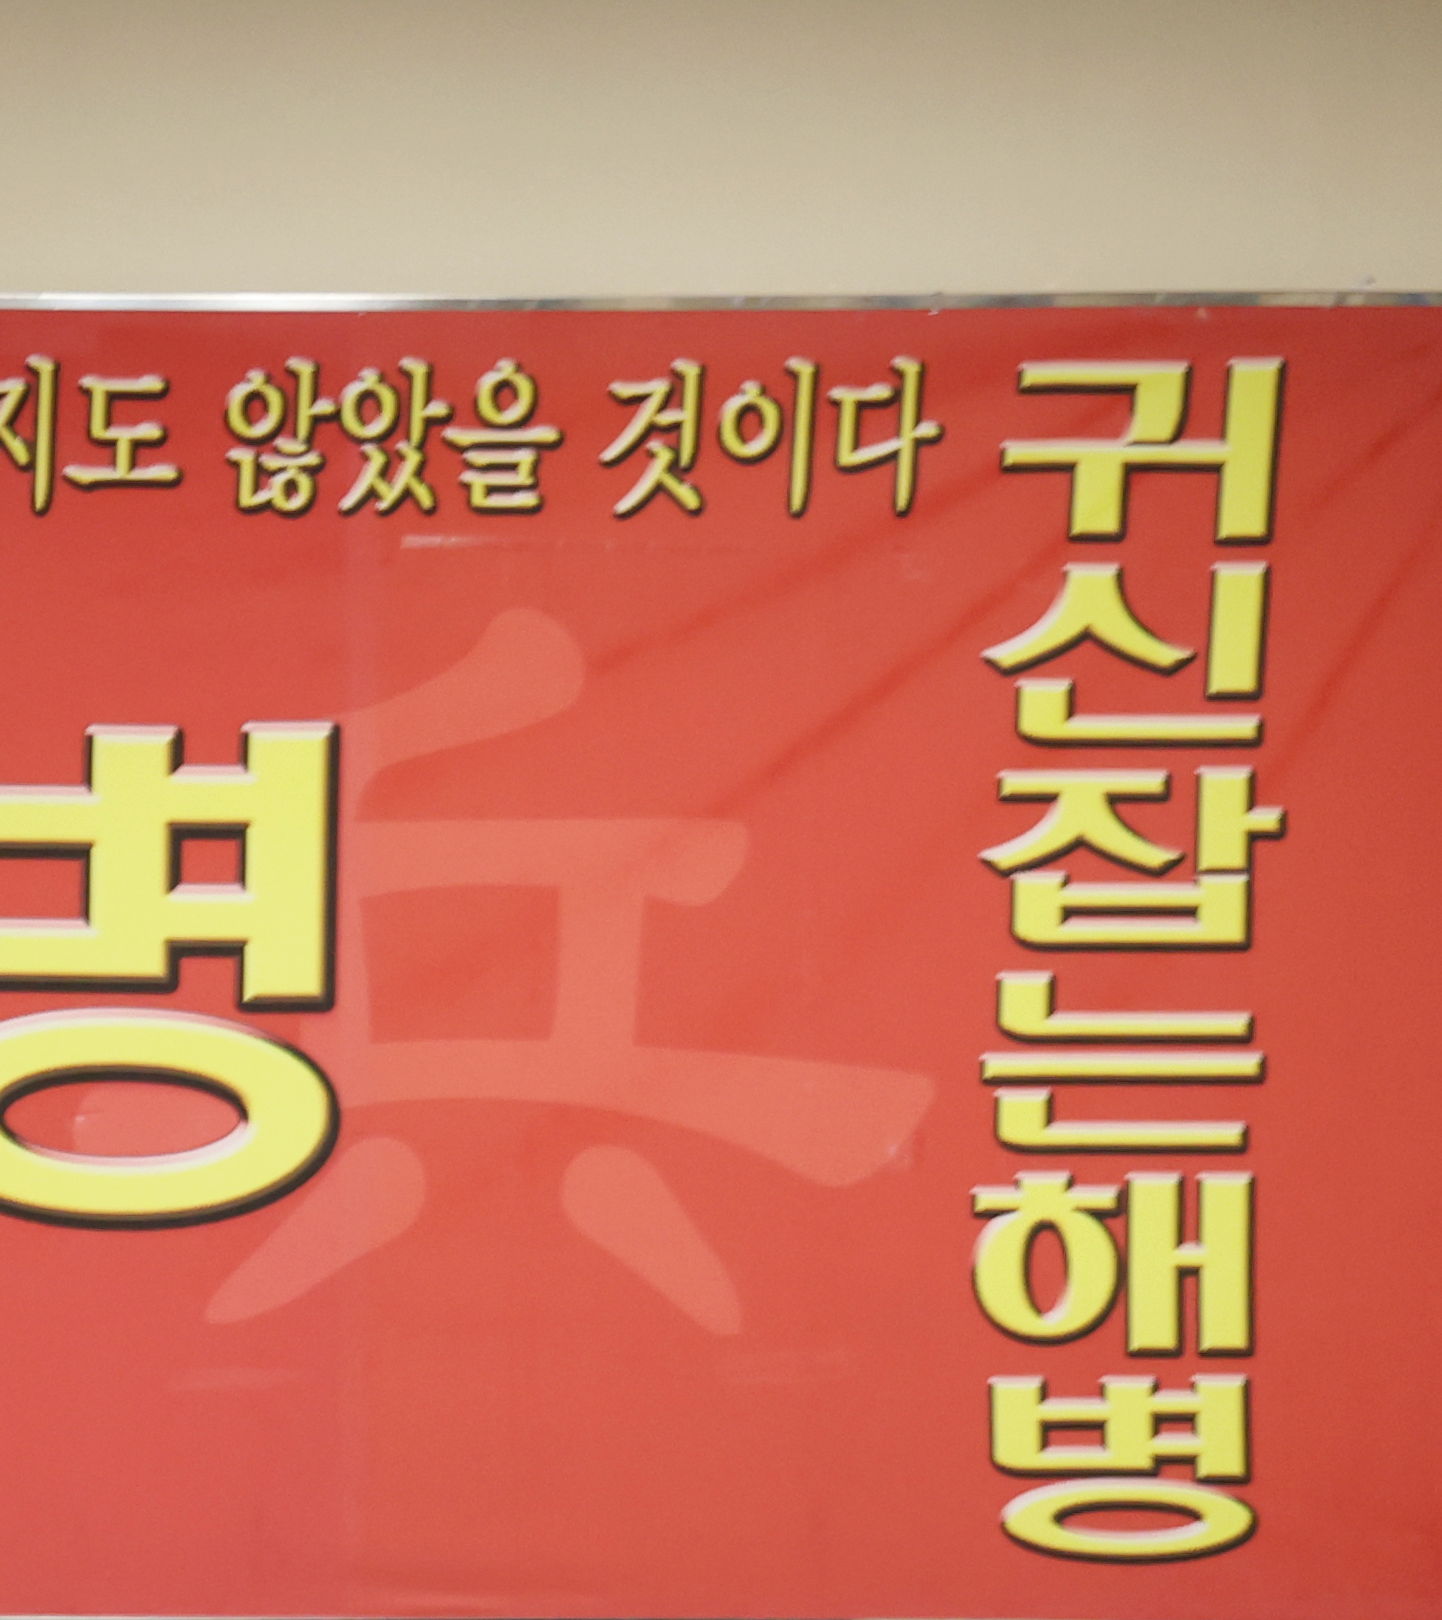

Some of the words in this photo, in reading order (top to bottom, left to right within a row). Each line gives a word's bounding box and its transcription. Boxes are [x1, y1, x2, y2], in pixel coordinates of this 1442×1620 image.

[223, 355, 563, 514] 않았을
[598, 355, 943, 517] 것이다
[968, 355, 1287, 1561] 귀신잡는해병
